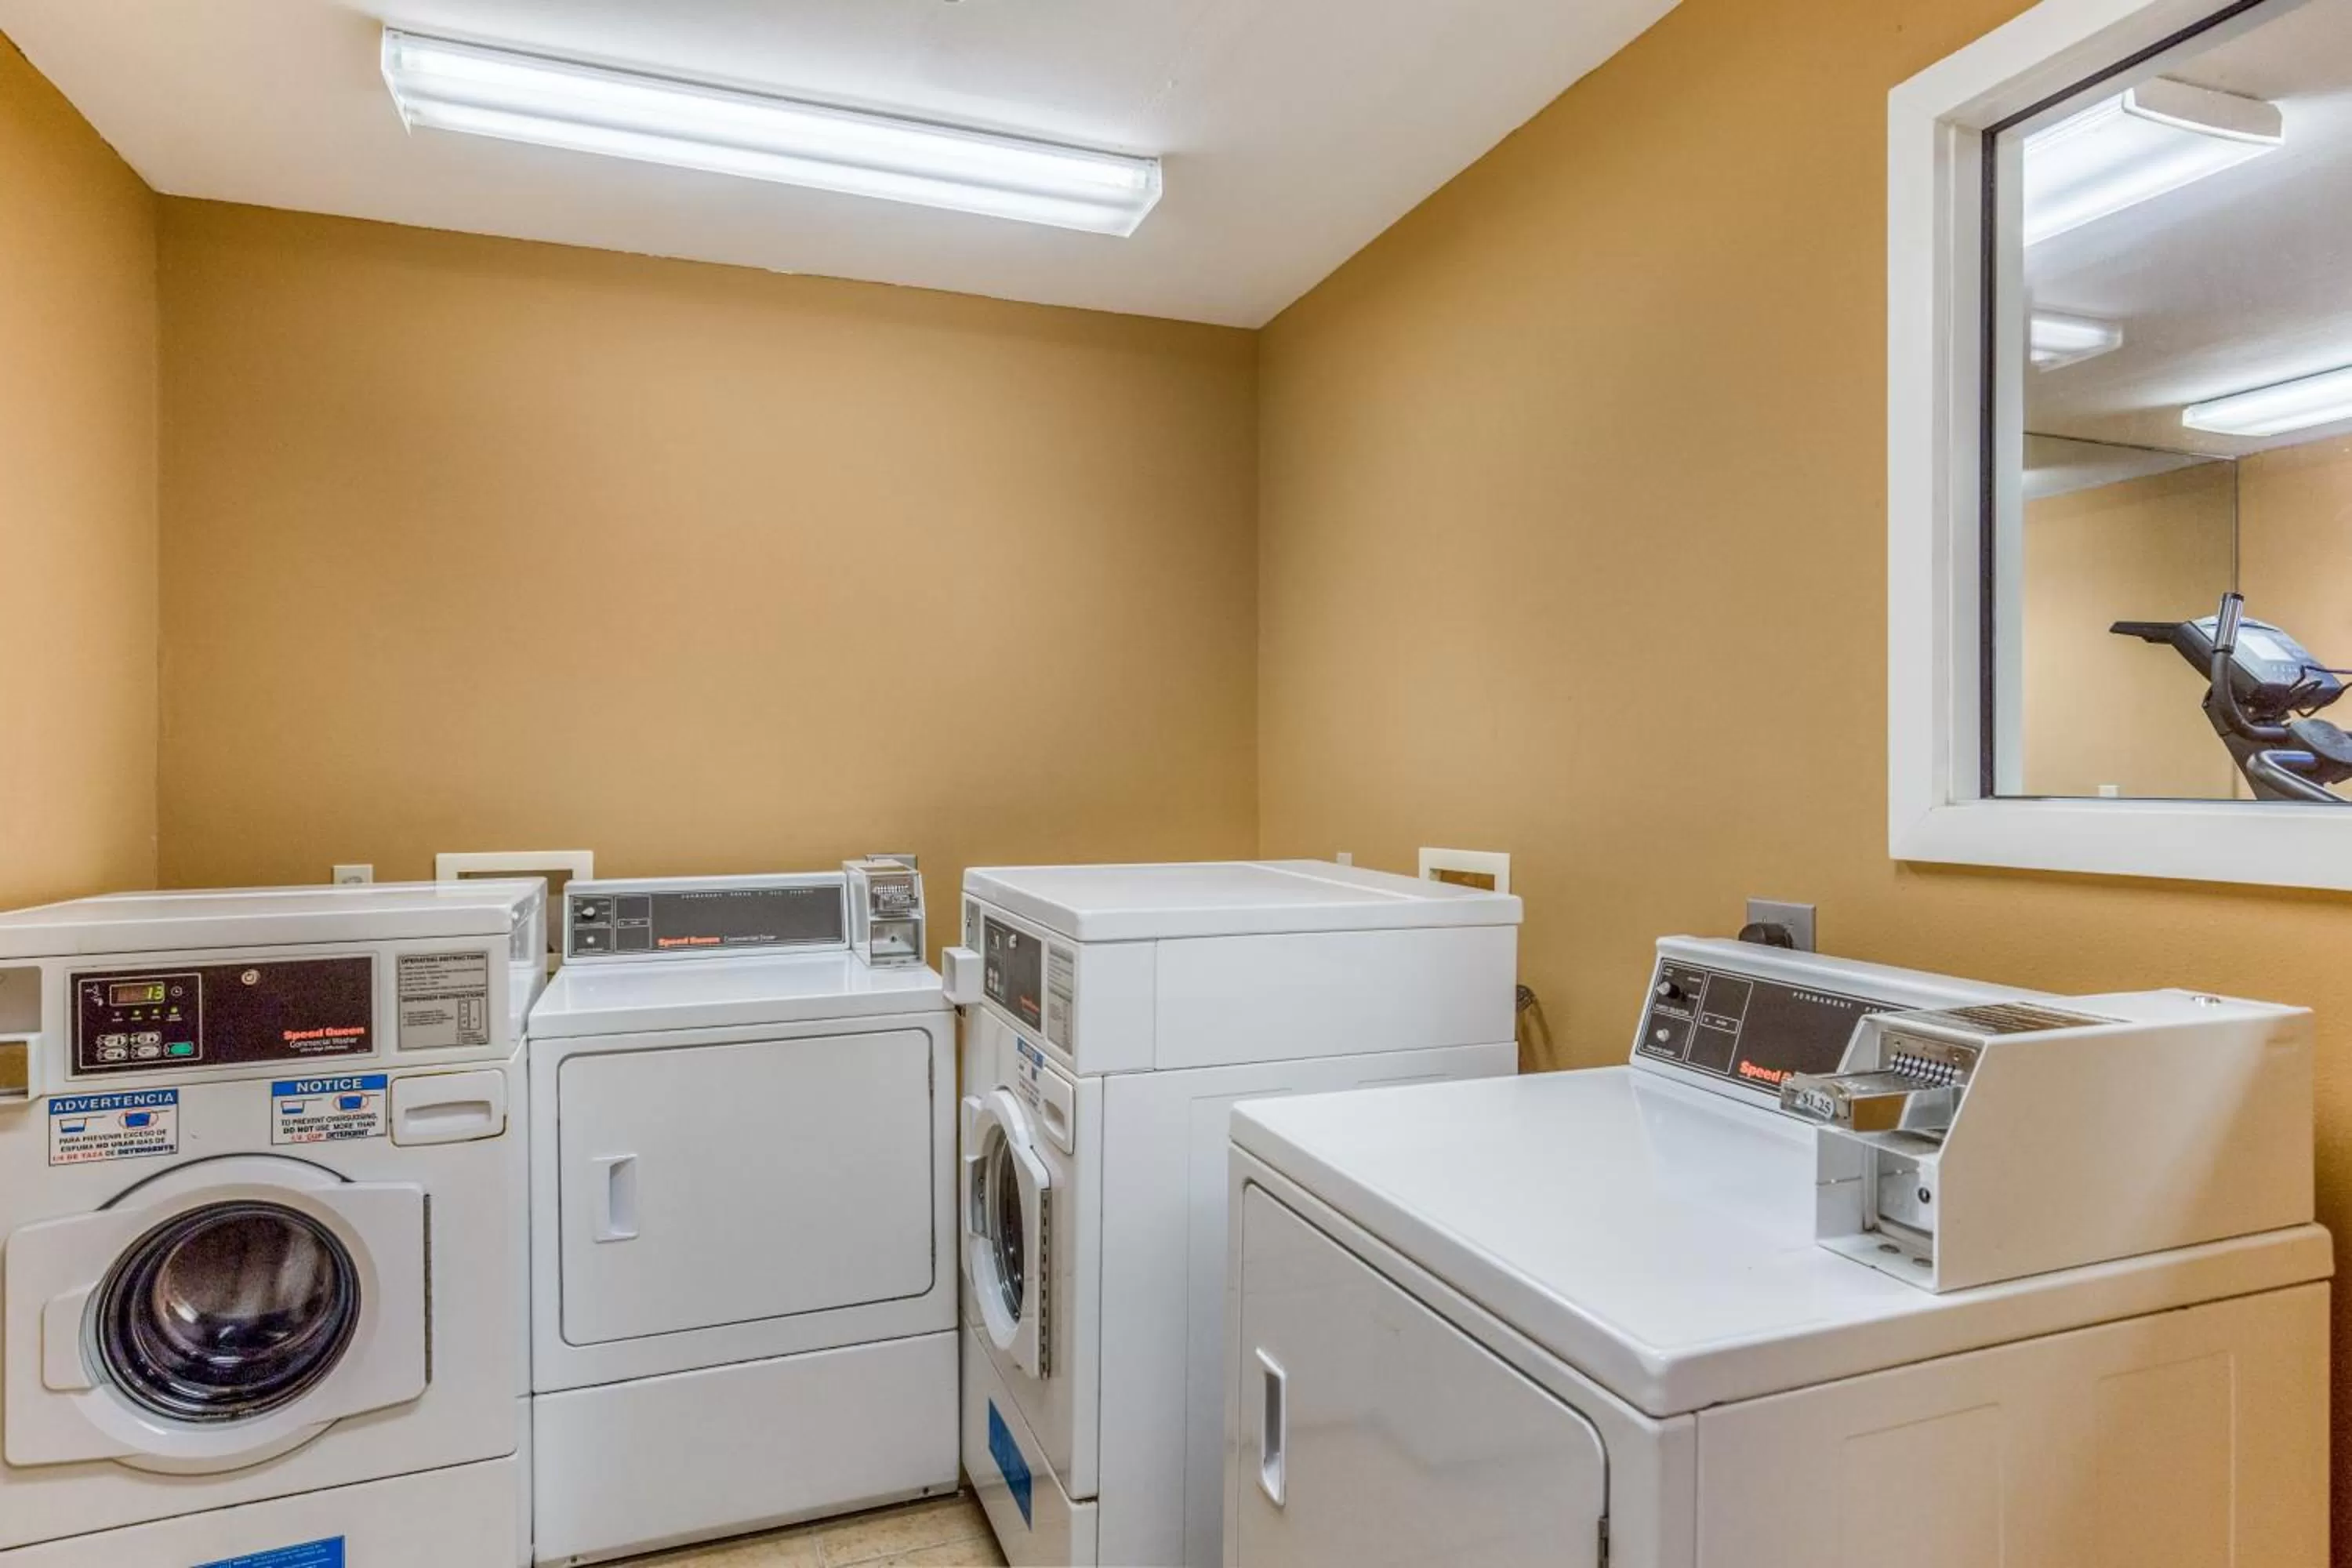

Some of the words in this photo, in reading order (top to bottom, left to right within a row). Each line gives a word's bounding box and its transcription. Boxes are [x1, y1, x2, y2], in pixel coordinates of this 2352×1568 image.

[1792, 991, 1852, 1009] PERMANENT
[283, 1028, 324, 1042] Speed
[325, 1026, 365, 1036] Queen
[1739, 1060, 1781, 1083] Speed
[296, 1078, 363, 1093] NOTICE
[53, 1092, 174, 1112] ADVERTENCIA
[281, 1118, 291, 1127] TO
[292, 1116, 325, 1125] PREVENT
[297, 1125, 314, 1134] NOT
[333, 1122, 353, 1131] MORE
[59, 1136, 81, 1145] PARA
[82, 1133, 122, 1142] PREVENIR
[123, 1130, 155, 1138] EXCESO
[325, 1129, 369, 1140] DETERGENT
[60, 1144, 93, 1152] ESPUMA
[111, 1140, 134, 1149] USAR
[67, 1152, 78, 1161] DE
[82, 1151, 103, 1160] TAZA
[117, 1144, 175, 1156] DETERGENTE
